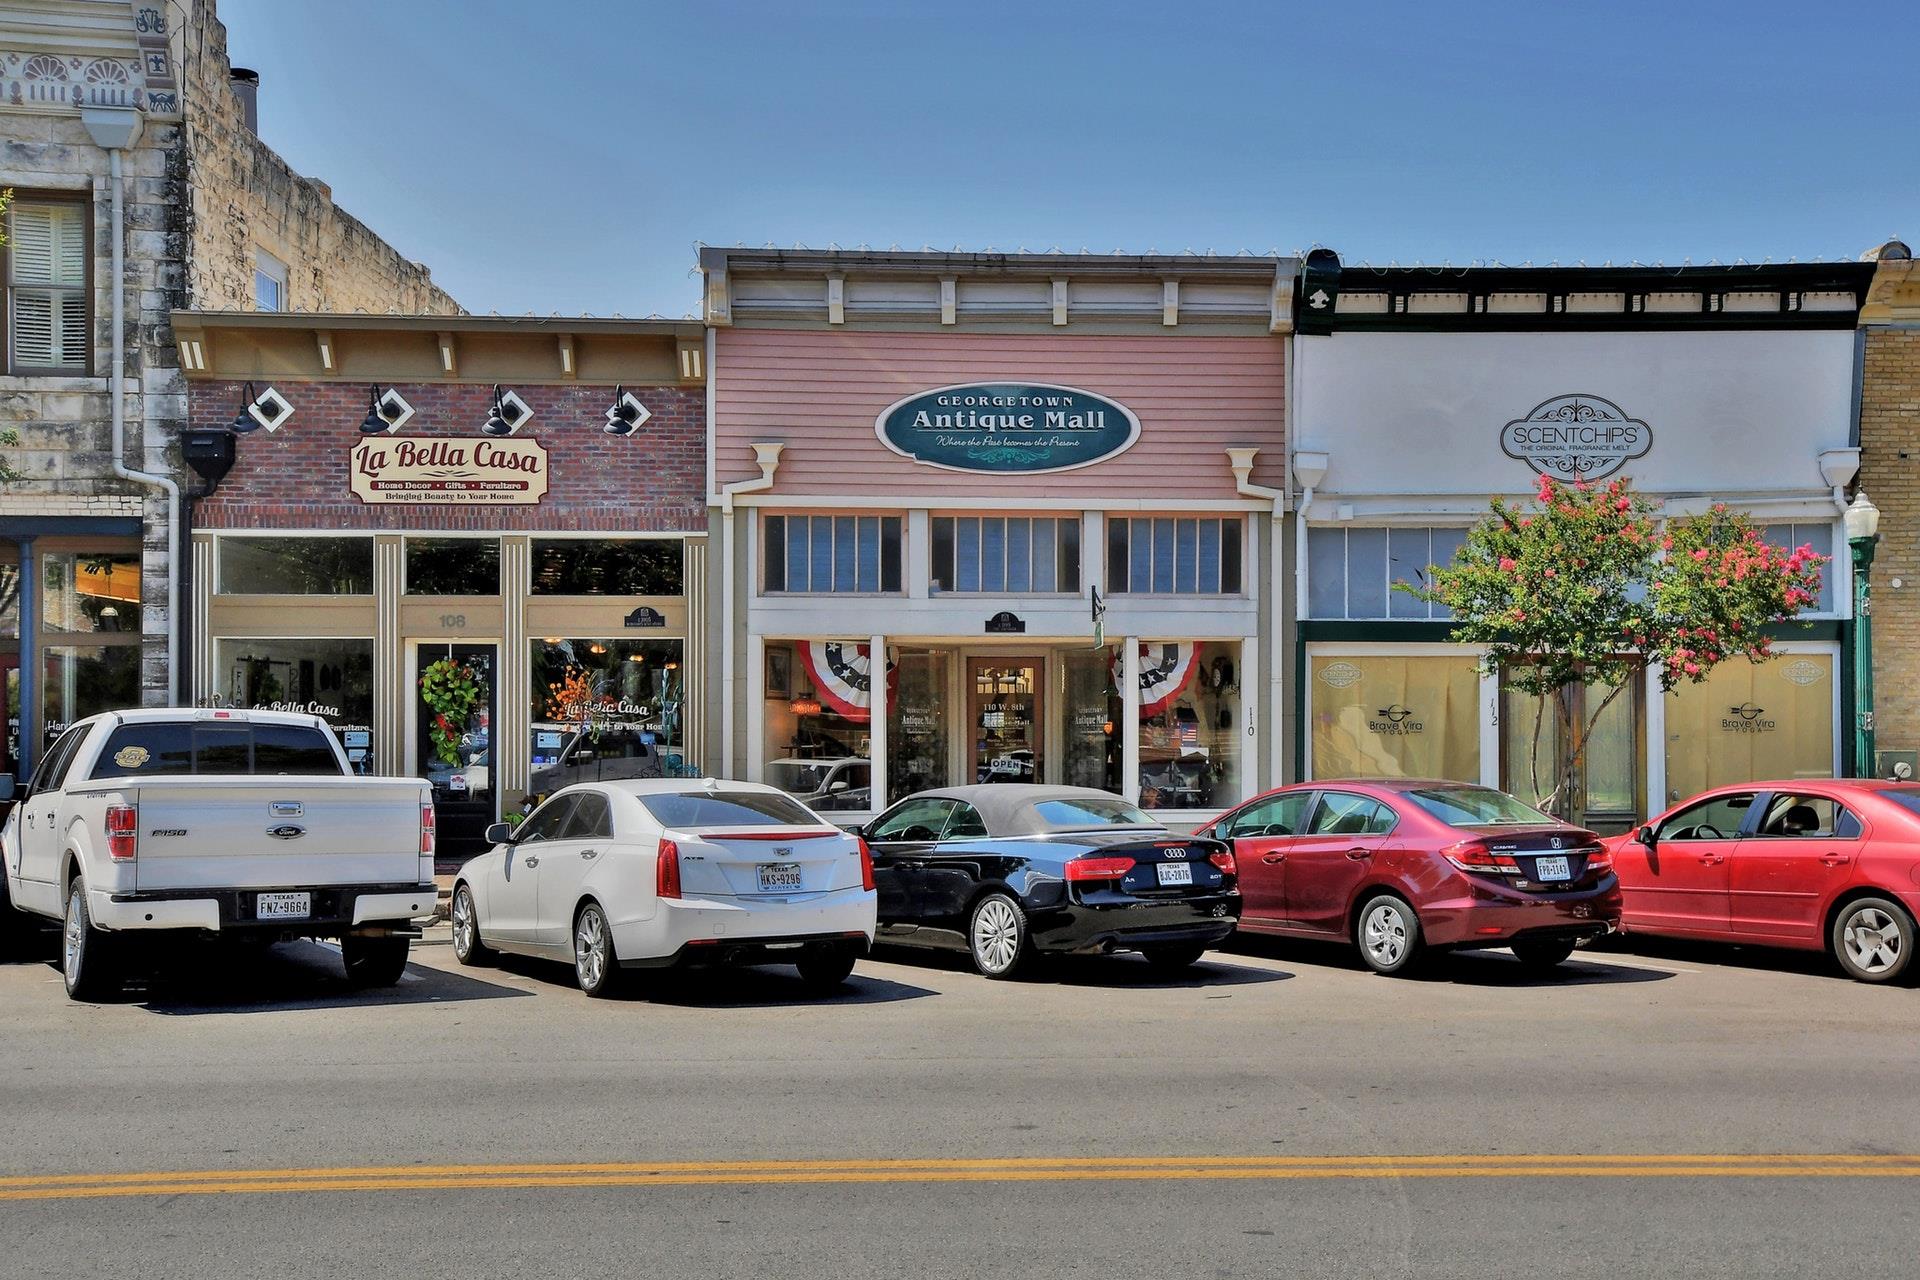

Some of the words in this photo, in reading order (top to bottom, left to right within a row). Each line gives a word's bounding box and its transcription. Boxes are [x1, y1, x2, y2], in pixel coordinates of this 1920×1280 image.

[937, 395, 1074, 407] GEORGETOWN
[911, 410, 1035, 433] Antique
[1044, 410, 1106, 430] Mall
[1513, 427, 1638, 444] SCENTCHIPS
[935, 435, 967, 447] Where
[967, 436, 981, 447] the
[981, 435, 1001, 447] Past
[1003, 436, 1033, 447] becomes
[1034, 436, 1048, 447] the
[1048, 435, 1080, 447] Present
[356, 444, 390, 478] La
[395, 441, 469, 468] Bella
[473, 441, 542, 474] Casa
[378, 482, 403, 490] Home
[405, 482, 432, 490] Decor
[445, 482, 466, 490] Gifts
[480, 482, 521, 490] Furniture
[385, 493, 422, 501] Bringing
[424, 493, 455, 501] Beauty
[307, 701, 341, 717] Casa
[618, 700, 650, 716] Casa
[984, 703, 996, 711] 110
[1369, 721, 1399, 730] Brave
[1402, 721, 1422, 730] Vira
[1722, 719, 1751, 728] Brave
[1755, 719, 1775, 728] Vira
[993, 760, 1020, 769] OPEN
[278, 828, 296, 836] Ford
